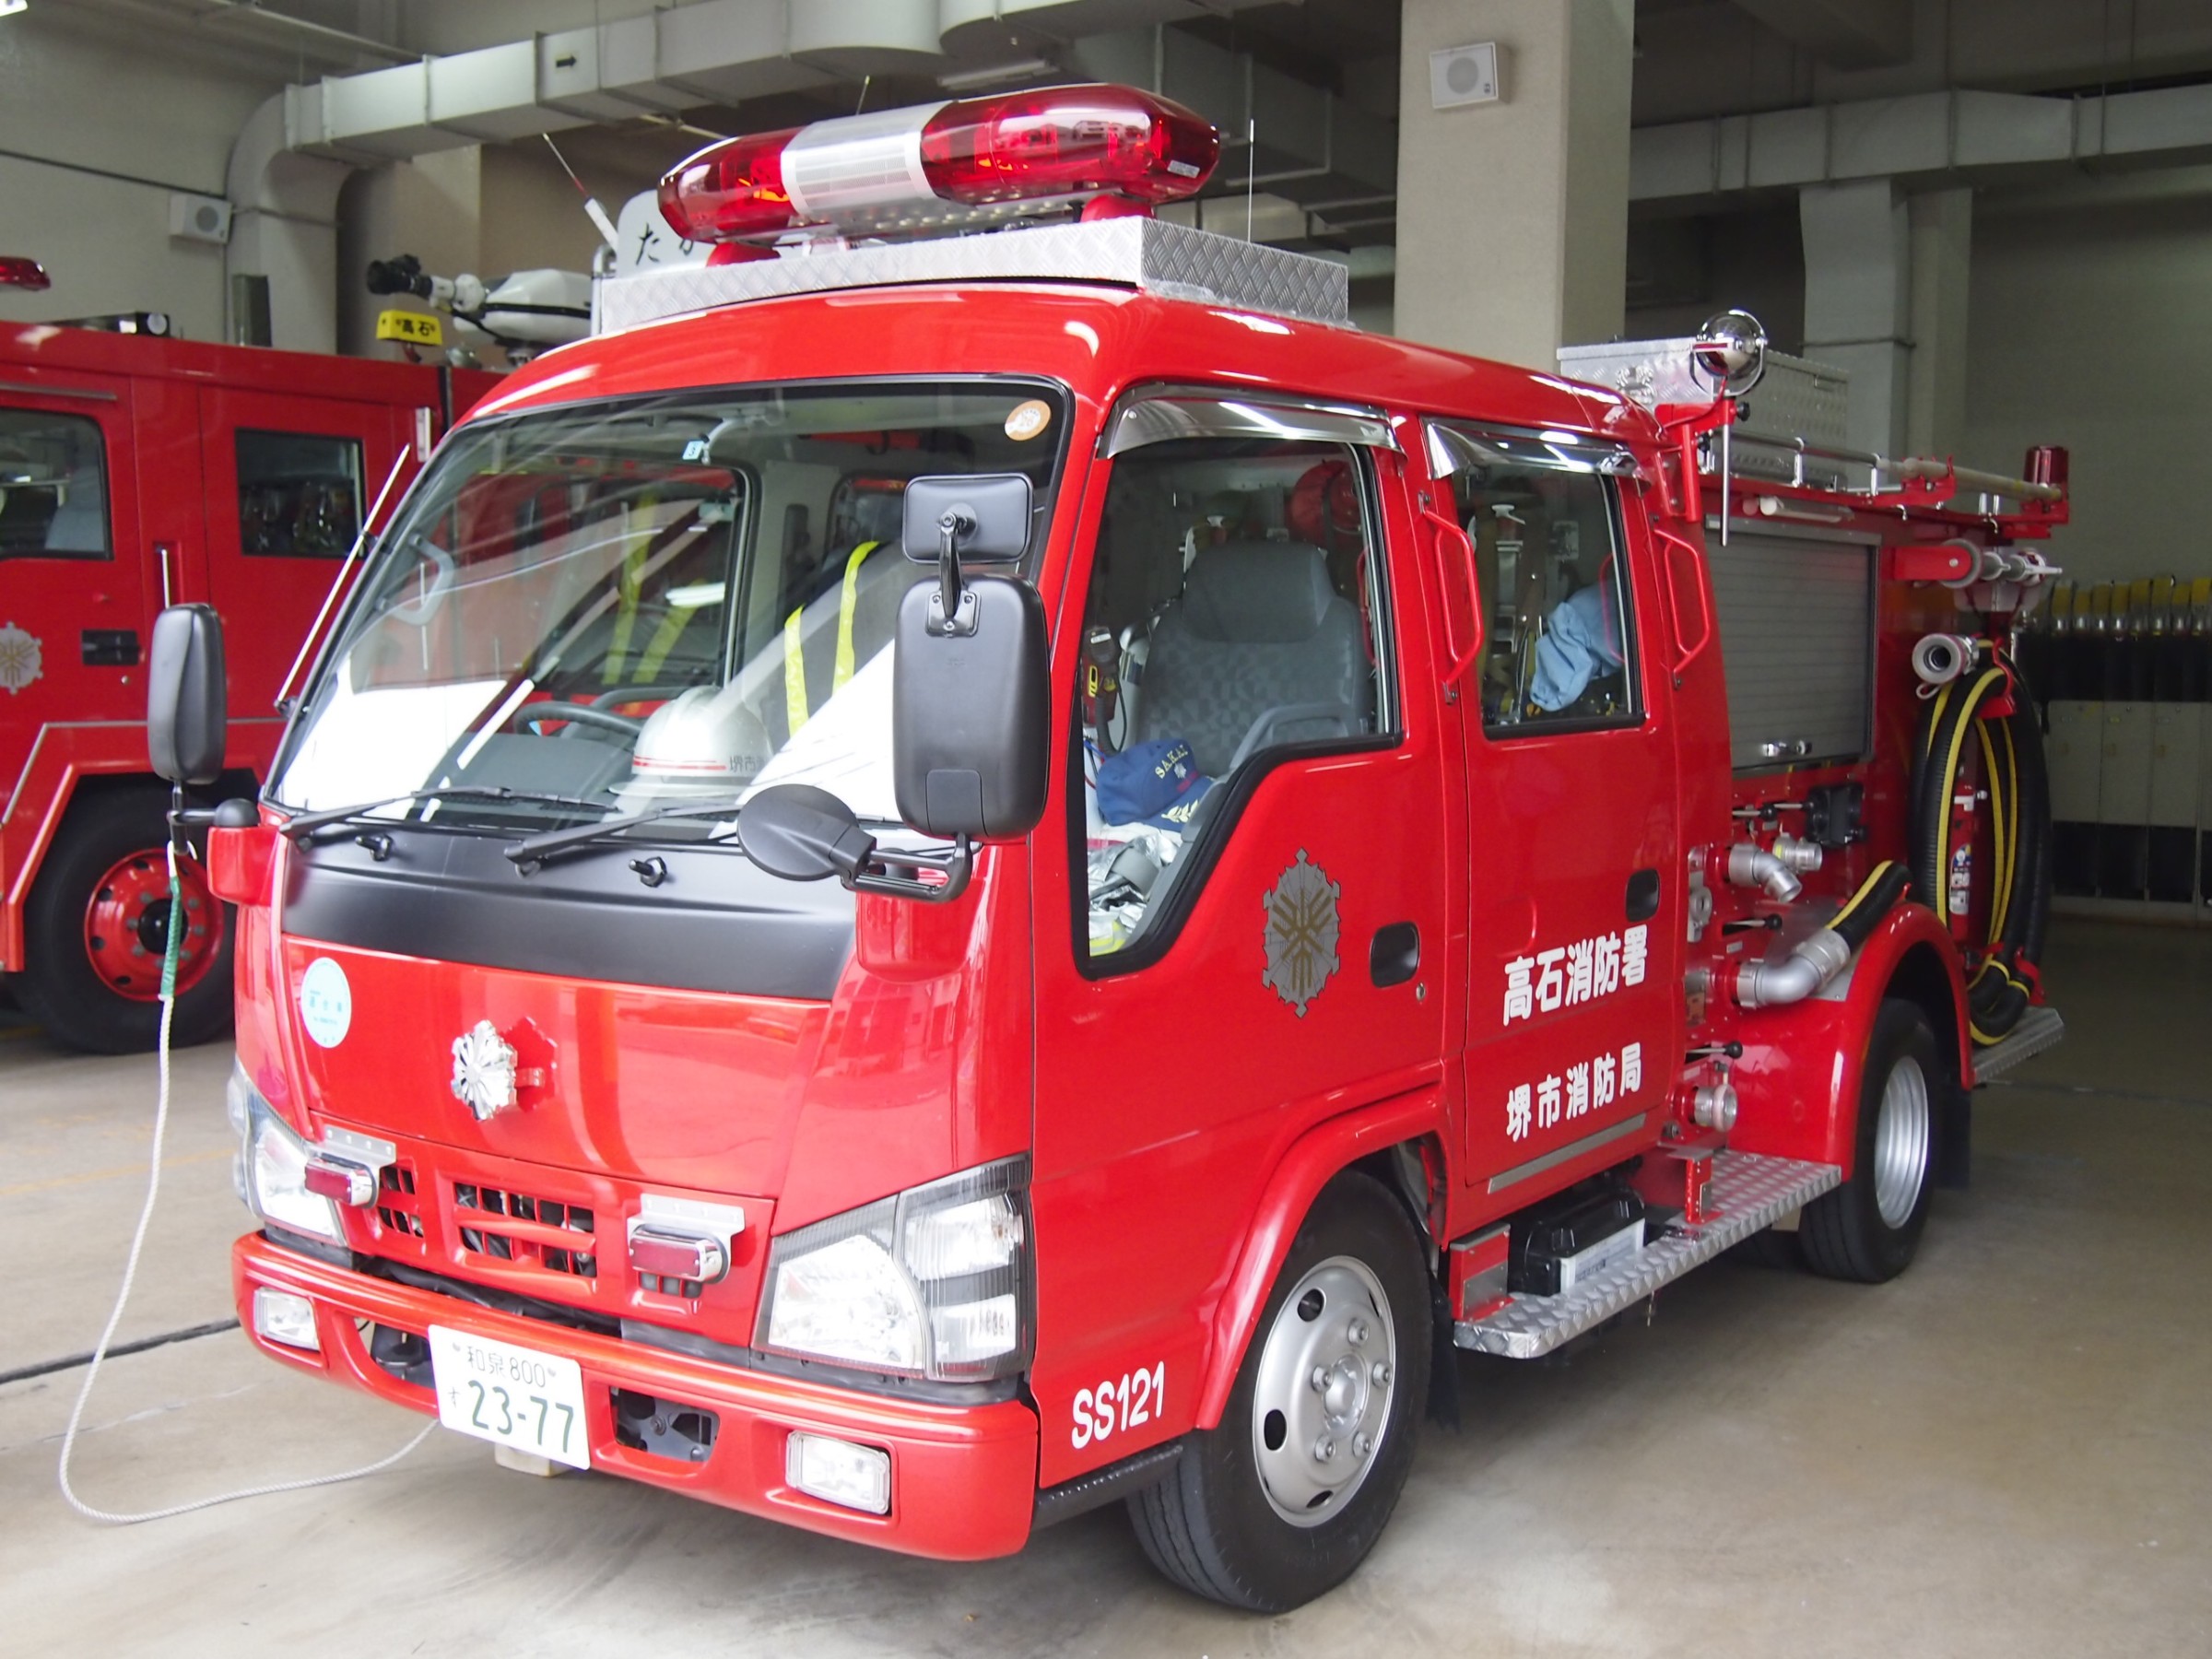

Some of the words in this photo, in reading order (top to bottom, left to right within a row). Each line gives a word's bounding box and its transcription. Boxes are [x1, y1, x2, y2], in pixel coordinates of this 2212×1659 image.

[1155, 745, 1188, 779] SAKAI
[1503, 924, 1647, 1026] 高石消防署
[1507, 1041, 1641, 1142] 堺市消防局
[468, 1380, 574, 1453] 23-77
[1072, 1360, 1164, 1449] SS121
